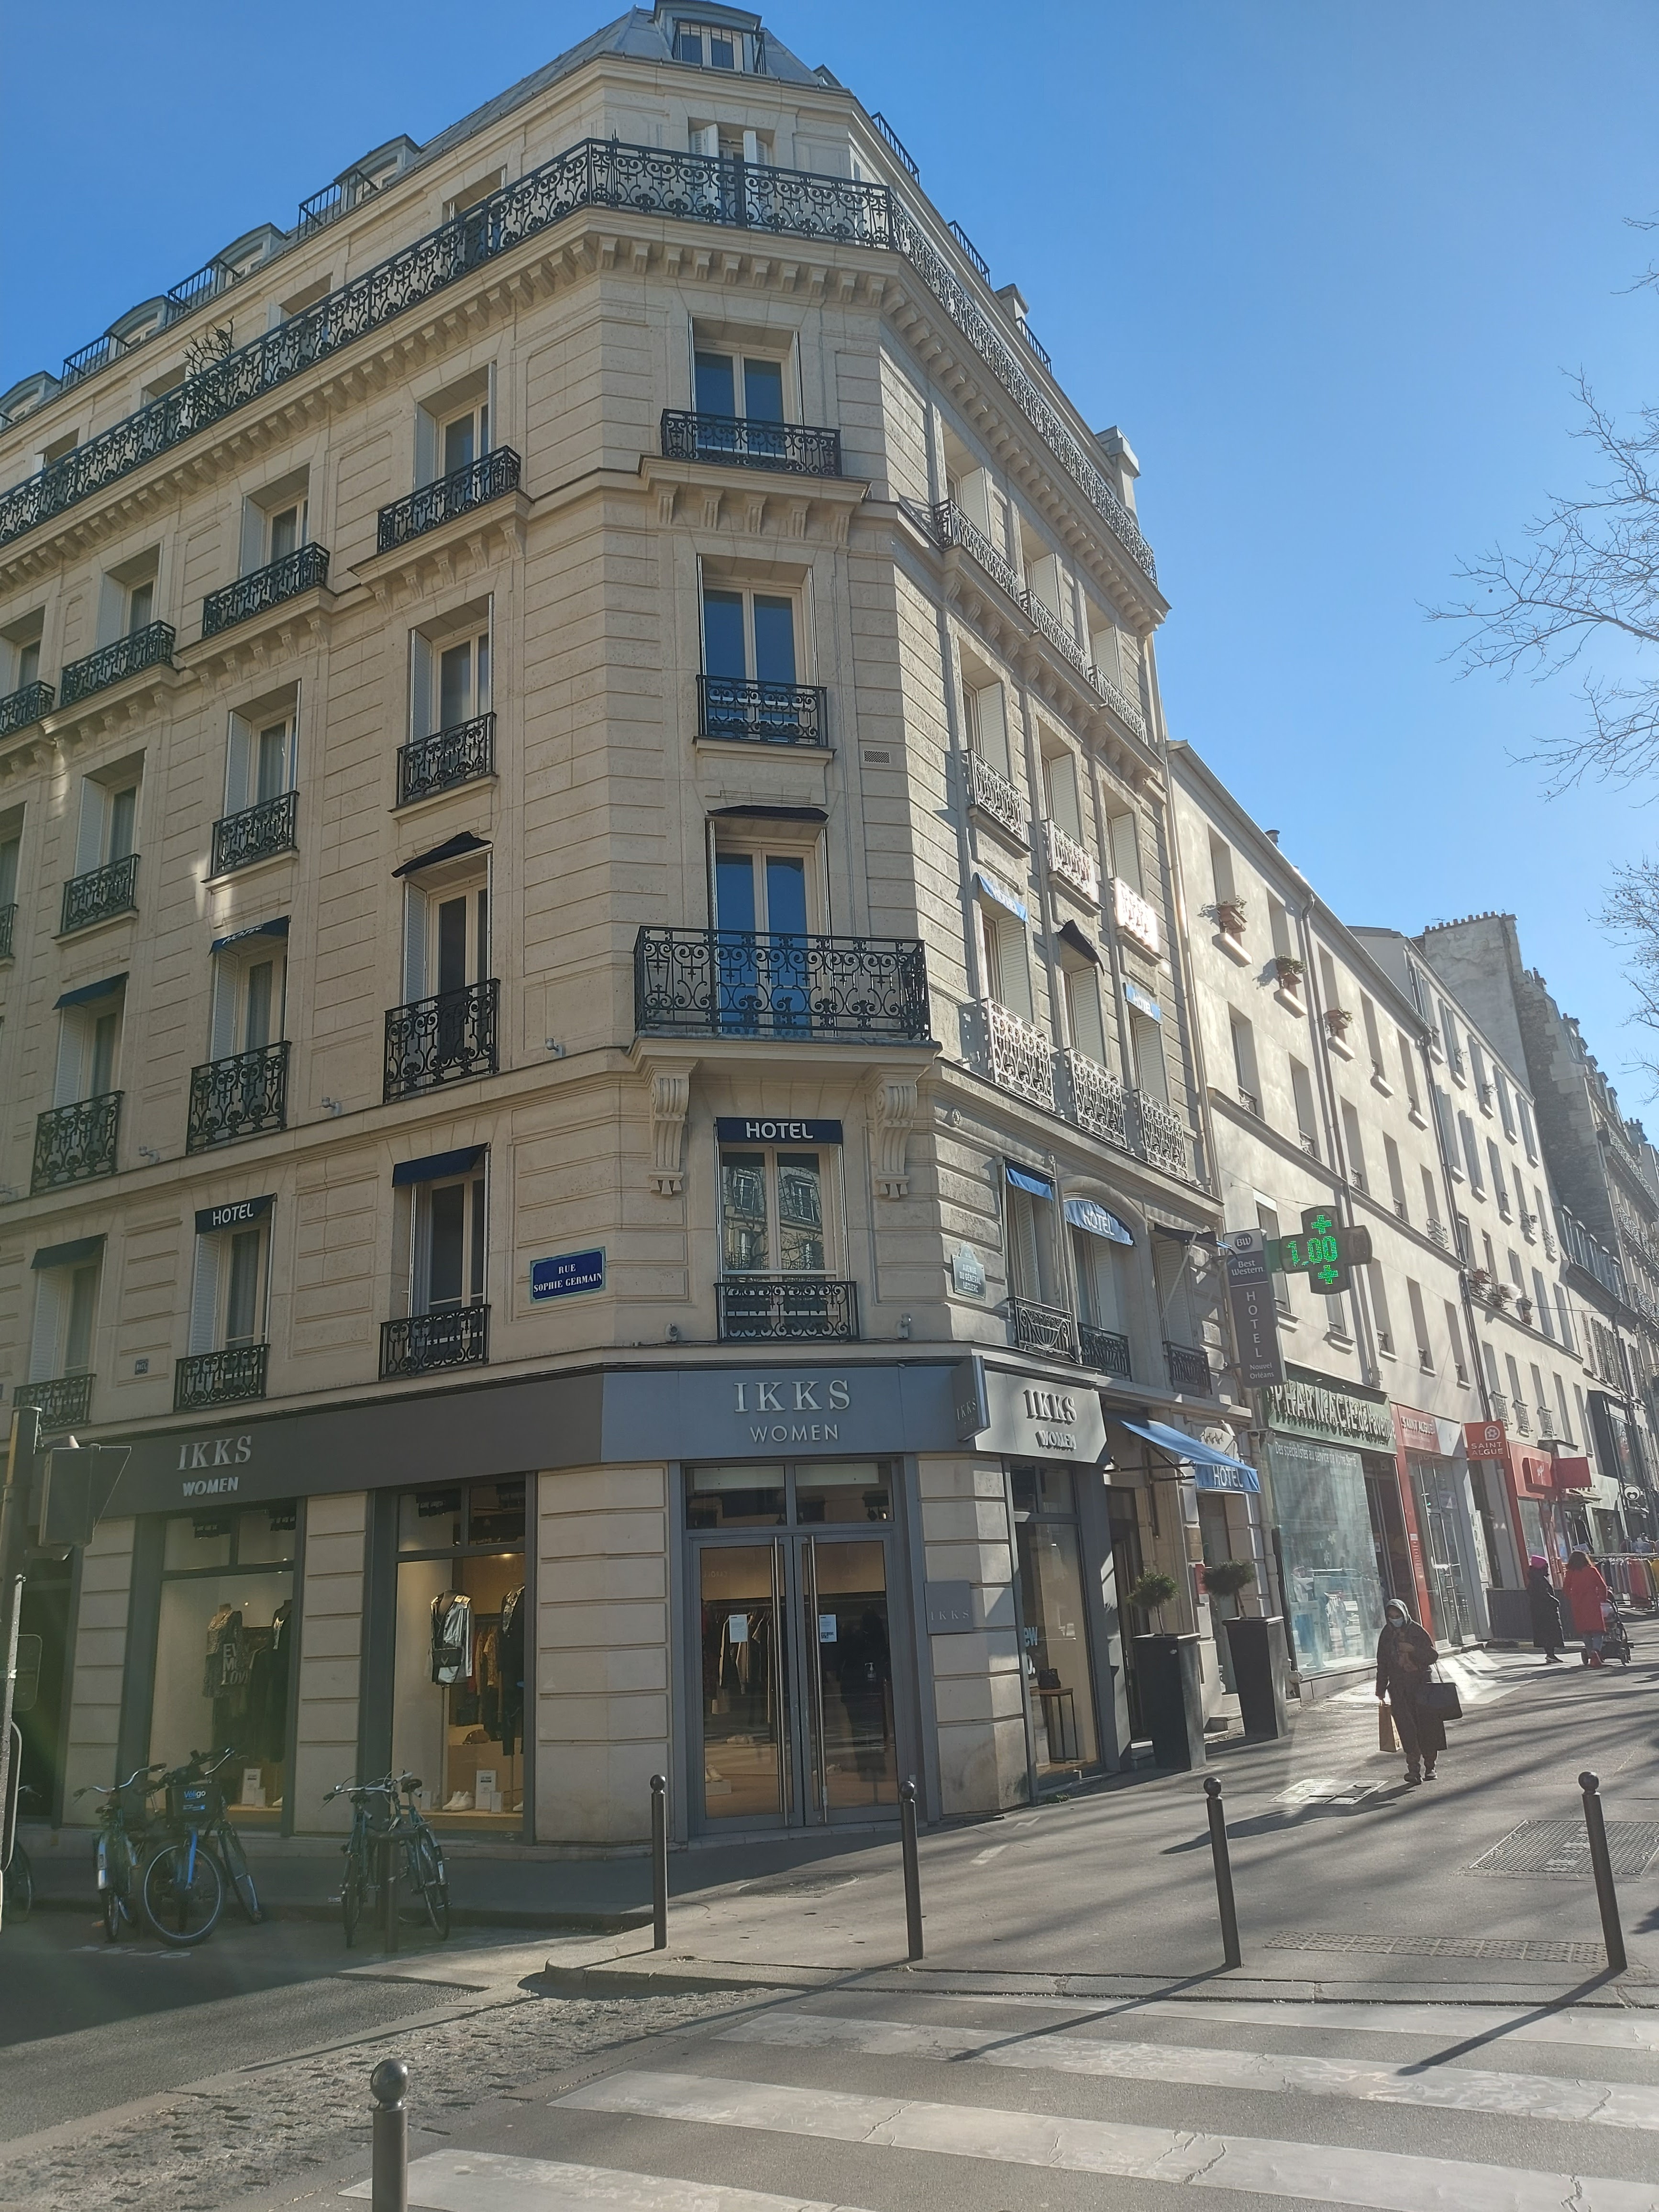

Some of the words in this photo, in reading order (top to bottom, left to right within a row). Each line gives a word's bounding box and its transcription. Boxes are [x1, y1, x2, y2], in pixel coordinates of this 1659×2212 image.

[746, 1122, 814, 1139] HOTEL
[213, 1203, 254, 1226] HOTEL
[1083, 1206, 1115, 1235] HOTEL
[1237, 1237, 1251, 1247] BW
[558, 1264, 576, 1274] RUE
[959, 1271, 965, 1280] DU
[963, 1264, 977, 1275] AVENUE
[1231, 1267, 1264, 1276] Western
[533, 1280, 563, 1293] SOPHIE
[565, 1272, 602, 1286] GERMAIN
[963, 1281, 978, 1293] LECLERC
[1247, 1291, 1262, 1357] HOTEL
[1250, 1362, 1272, 1371] Nouvel
[734, 1380, 851, 1412] IKKS
[1274, 1380, 1358, 1429] PHARMACIE
[957, 1398, 976, 1420] IKKS
[1023, 1389, 1077, 1424] IKKS
[750, 1424, 838, 1443] WOMEN
[1401, 1416, 1417, 1432] SAINT
[1035, 1430, 1077, 1450] WOMEN
[1275, 1441, 1284, 1455] Des
[176, 1436, 252, 1471] IKKS
[1213, 1465, 1243, 1488] HOTEL
[183, 1477, 239, 1497] WOMEN
[931, 1609, 969, 1621] IKKS
[184, 1790, 206, 1798] Véligo
